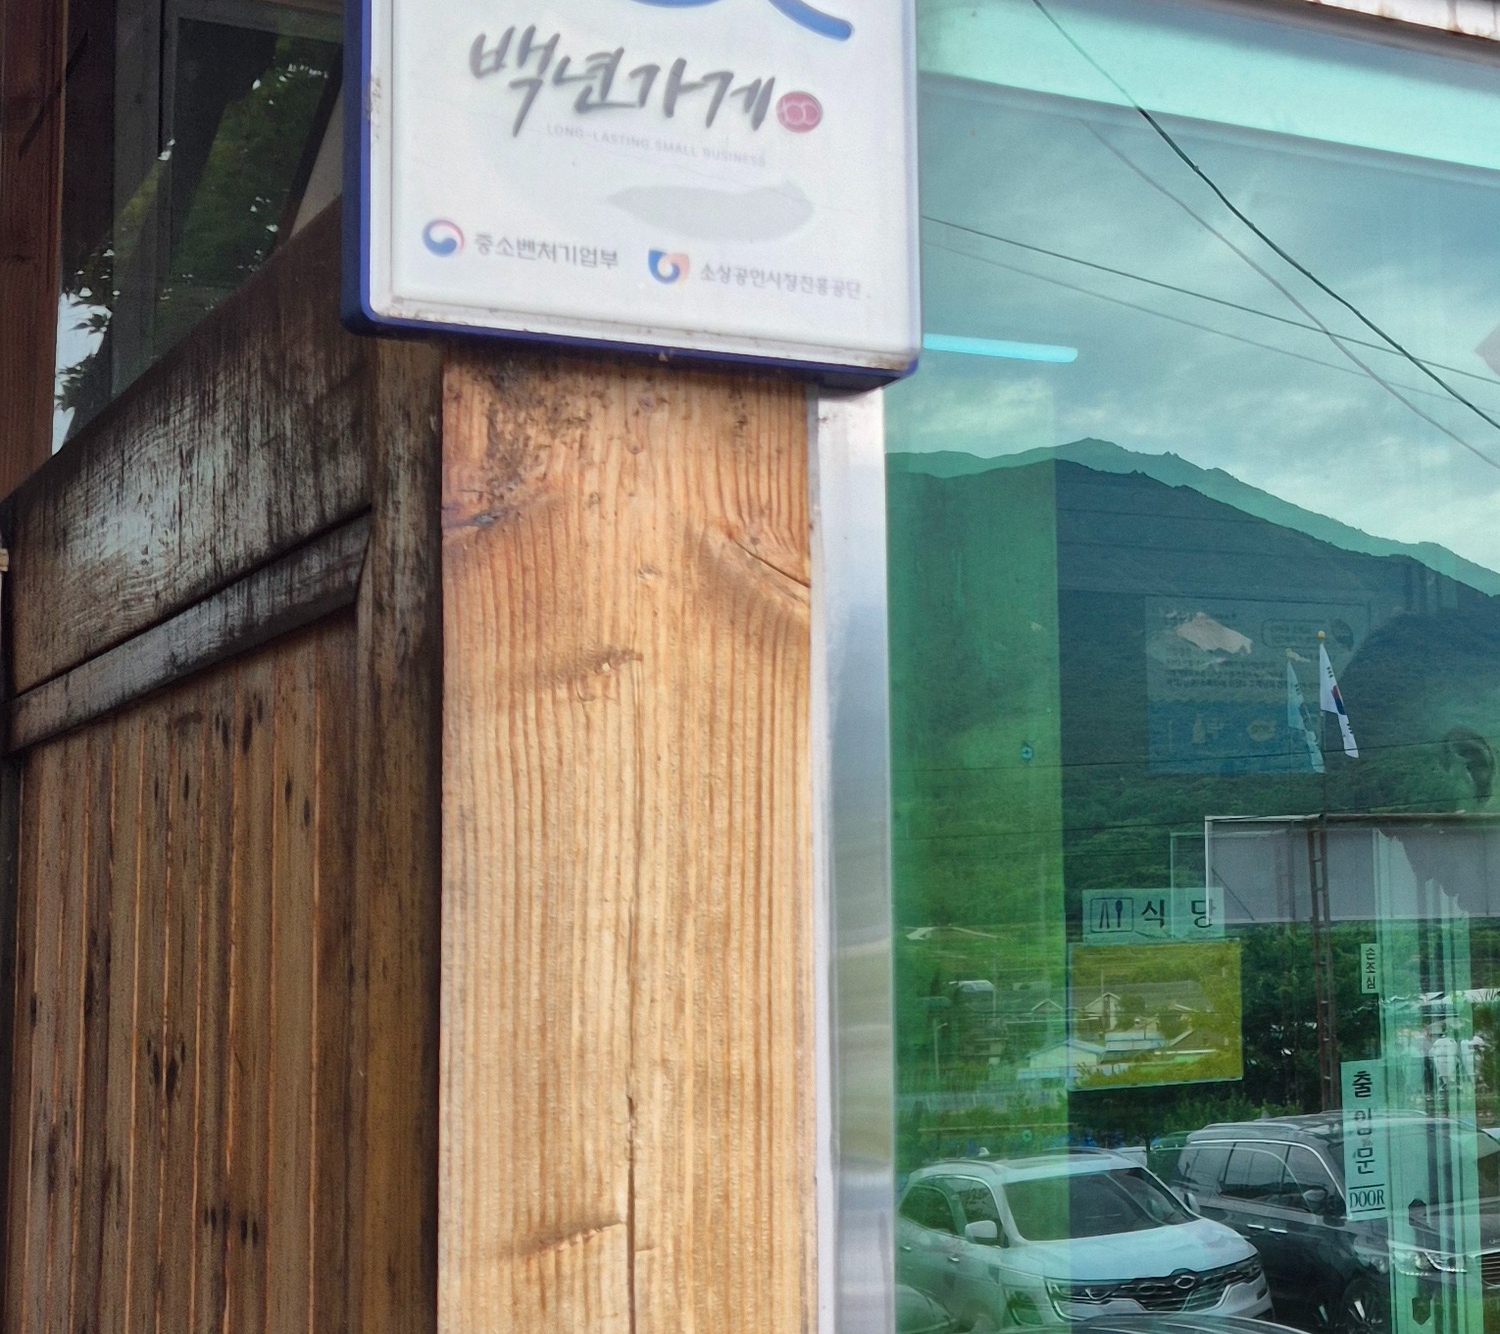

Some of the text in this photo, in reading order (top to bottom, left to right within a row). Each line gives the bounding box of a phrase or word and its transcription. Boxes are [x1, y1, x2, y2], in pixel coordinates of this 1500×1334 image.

[469, 24, 777, 139] 백년가게
[475, 232, 619, 271] 중소벤처기업부
[700, 262, 862, 300] 소상공인시장진흥공단
[1348, 1188, 1386, 1211] DOOR
